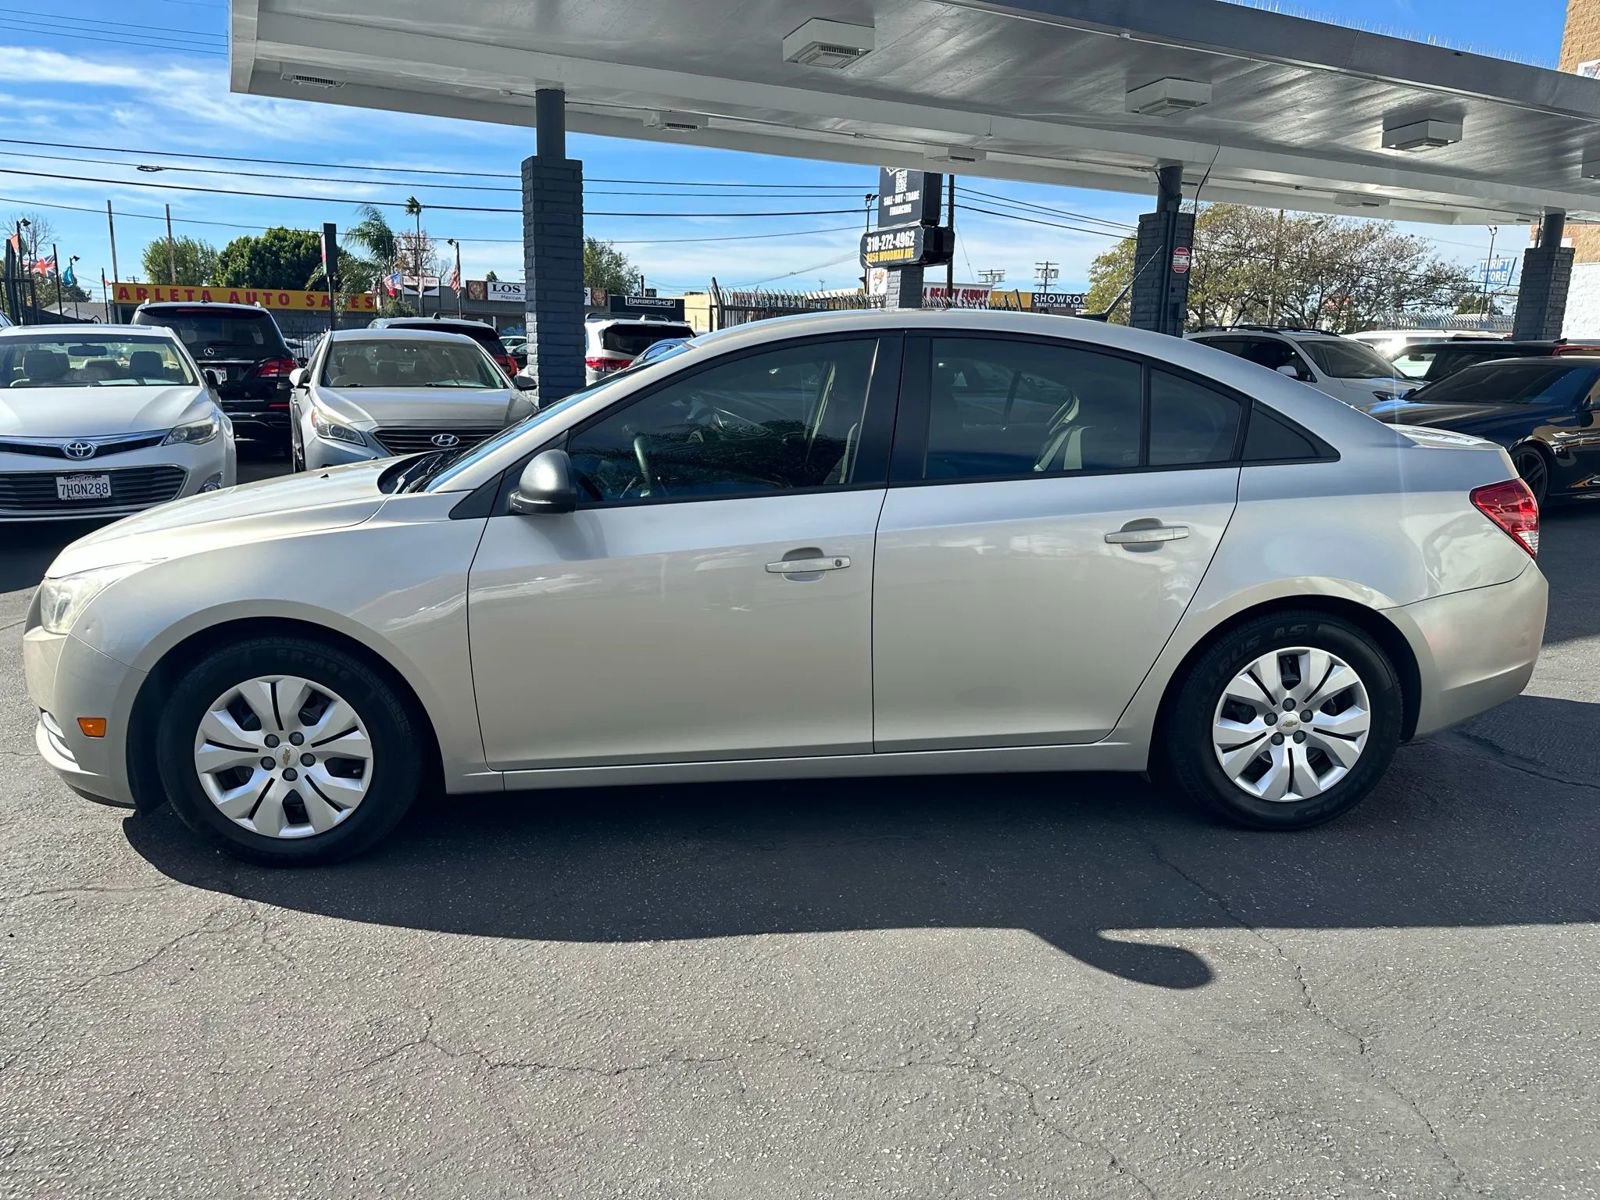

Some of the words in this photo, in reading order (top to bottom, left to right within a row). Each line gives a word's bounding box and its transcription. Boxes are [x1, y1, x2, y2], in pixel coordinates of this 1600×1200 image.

[866, 231, 915, 252] 310-272-4962
[492, 284, 521, 294] LOS
[118, 286, 213, 302] ARLETA
[229, 290, 291, 306] AUTO
[305, 291, 375, 310] SAES
[1033, 294, 1089, 304] SHOWROO
[59, 483, 109, 496] 7HQN288
